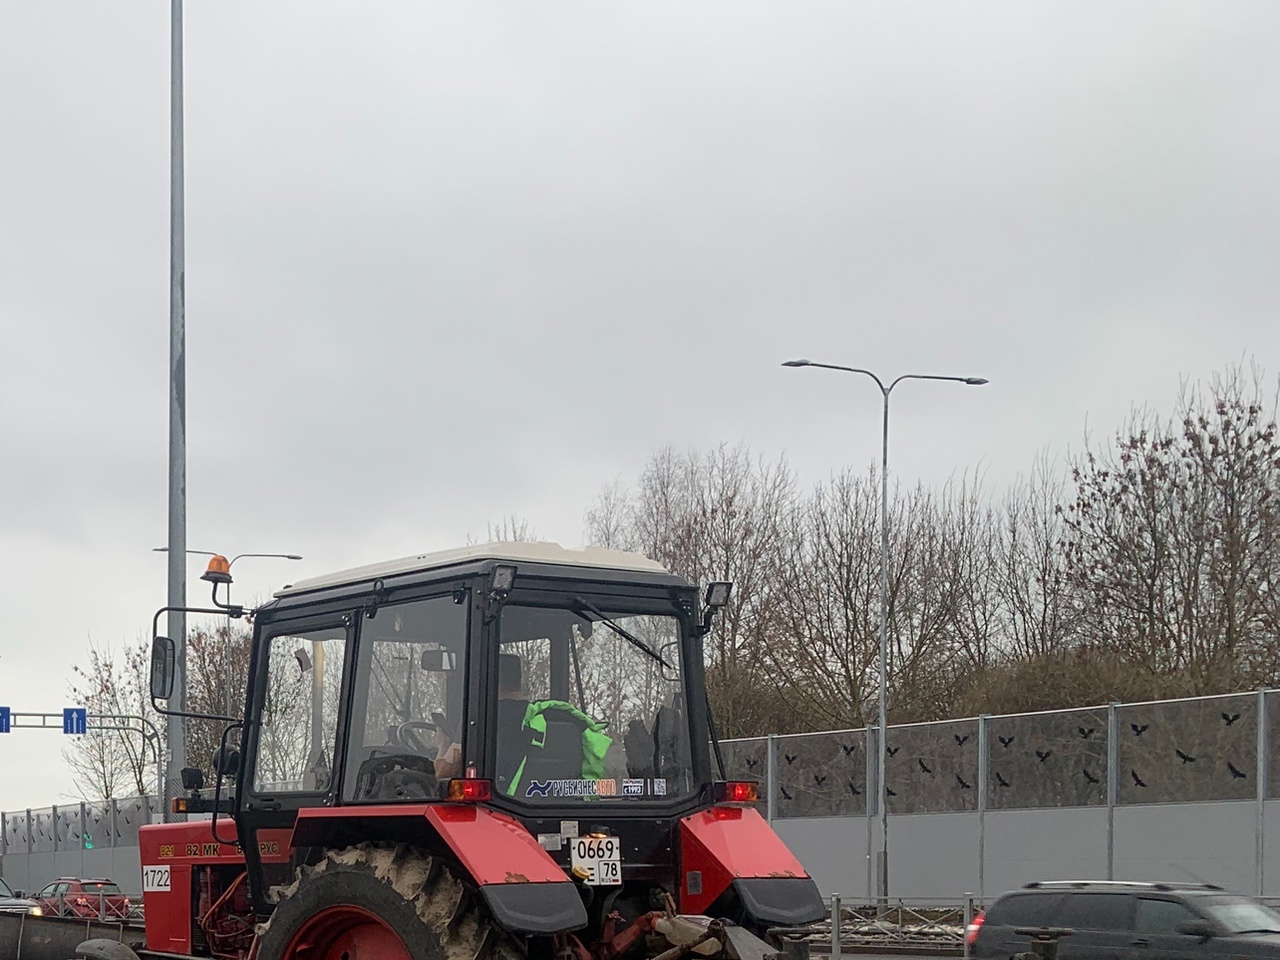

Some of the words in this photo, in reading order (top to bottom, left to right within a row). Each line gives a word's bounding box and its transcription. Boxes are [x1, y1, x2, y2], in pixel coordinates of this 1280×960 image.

[552, 778, 616, 796] РУСБИЗНЕСАВТО
[577, 840, 614, 859] 0669
[144, 869, 170, 888] 1722
[603, 862, 618, 877] 78
